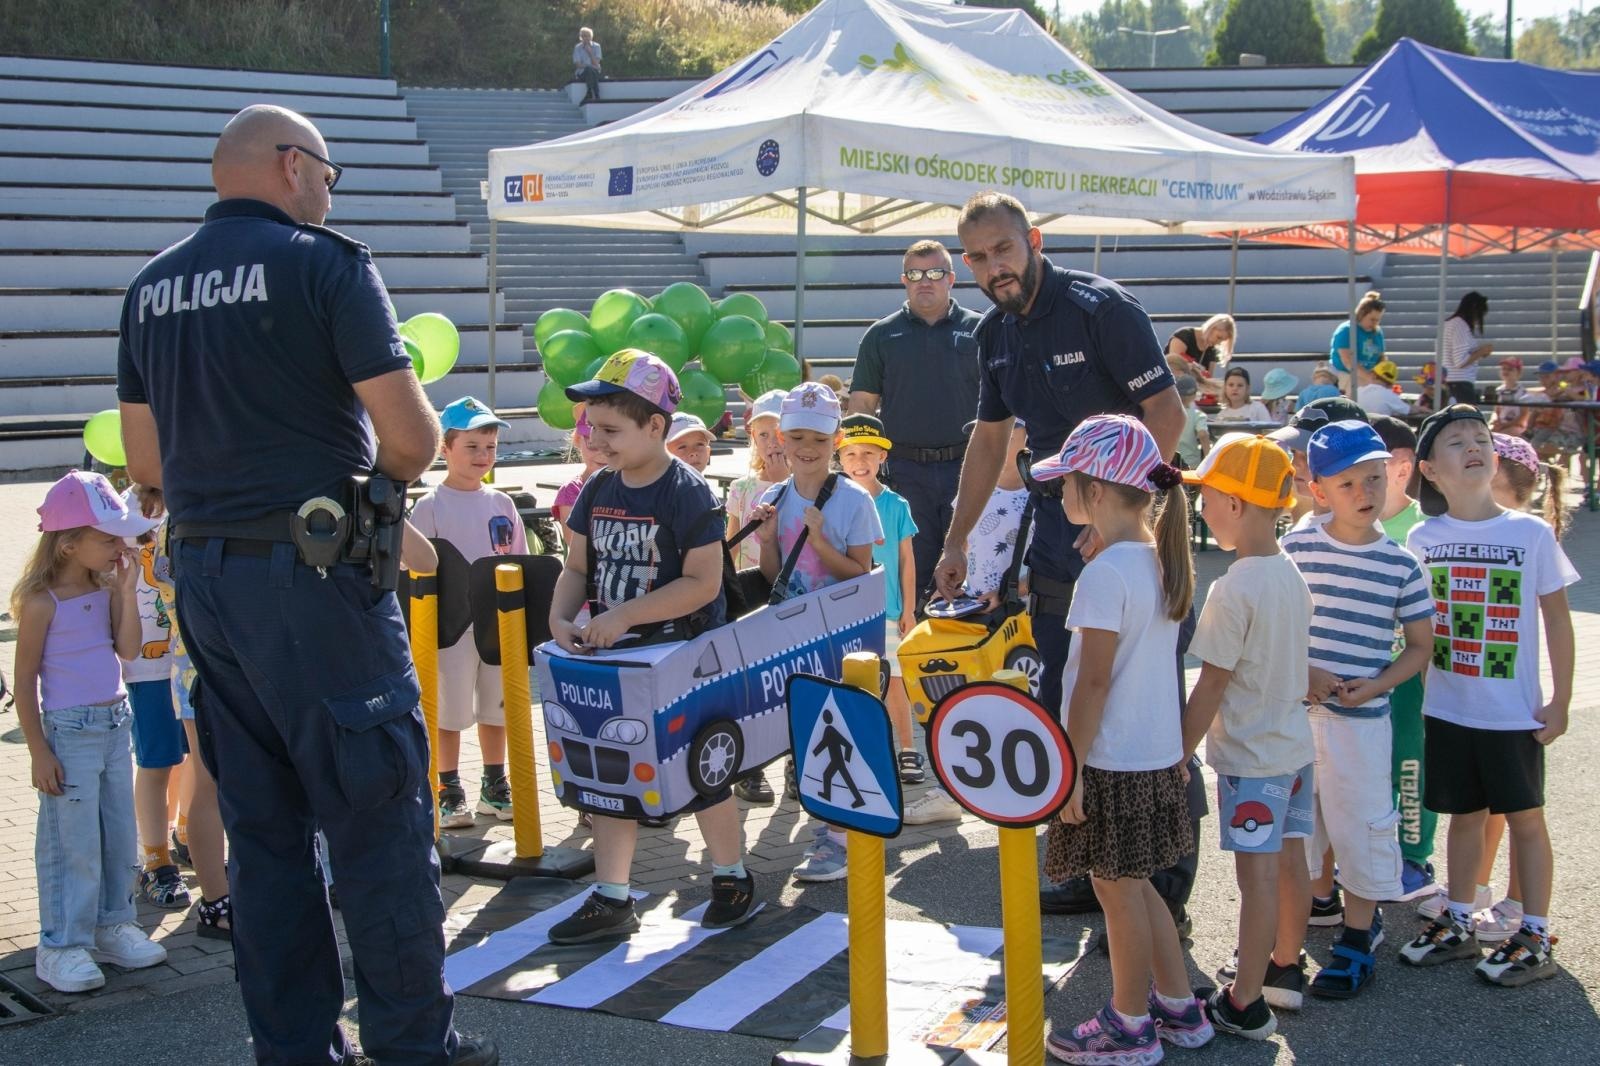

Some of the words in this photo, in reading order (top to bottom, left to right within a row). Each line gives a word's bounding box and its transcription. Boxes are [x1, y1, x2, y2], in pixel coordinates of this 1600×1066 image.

[840, 146, 909, 175] MIEJSKI
[914, 153, 998, 185] OŚRODEK
[1002, 166, 1067, 191] SPORTU
[1070, 173, 1076, 192] I
[1080, 174, 1158, 197] REKREACJI
[1161, 178, 1244, 200] "CENTRUM"
[1248, 191, 1257, 201] w
[138, 263, 269, 324] POLICJA
[1127, 365, 1165, 392] POLICJA
[592, 519, 662, 563] WORK
[1422, 543, 1526, 566] MINECRAFT
[1455, 578, 1482, 590] TNT
[1491, 618, 1517, 629] TNT
[1455, 652, 1478, 663] TNT
[560, 681, 614, 711] POLICJA
[950, 719, 1051, 797] 30
[585, 792, 620, 810] TEL112
[1400, 759, 1421, 845] GARFIELD
